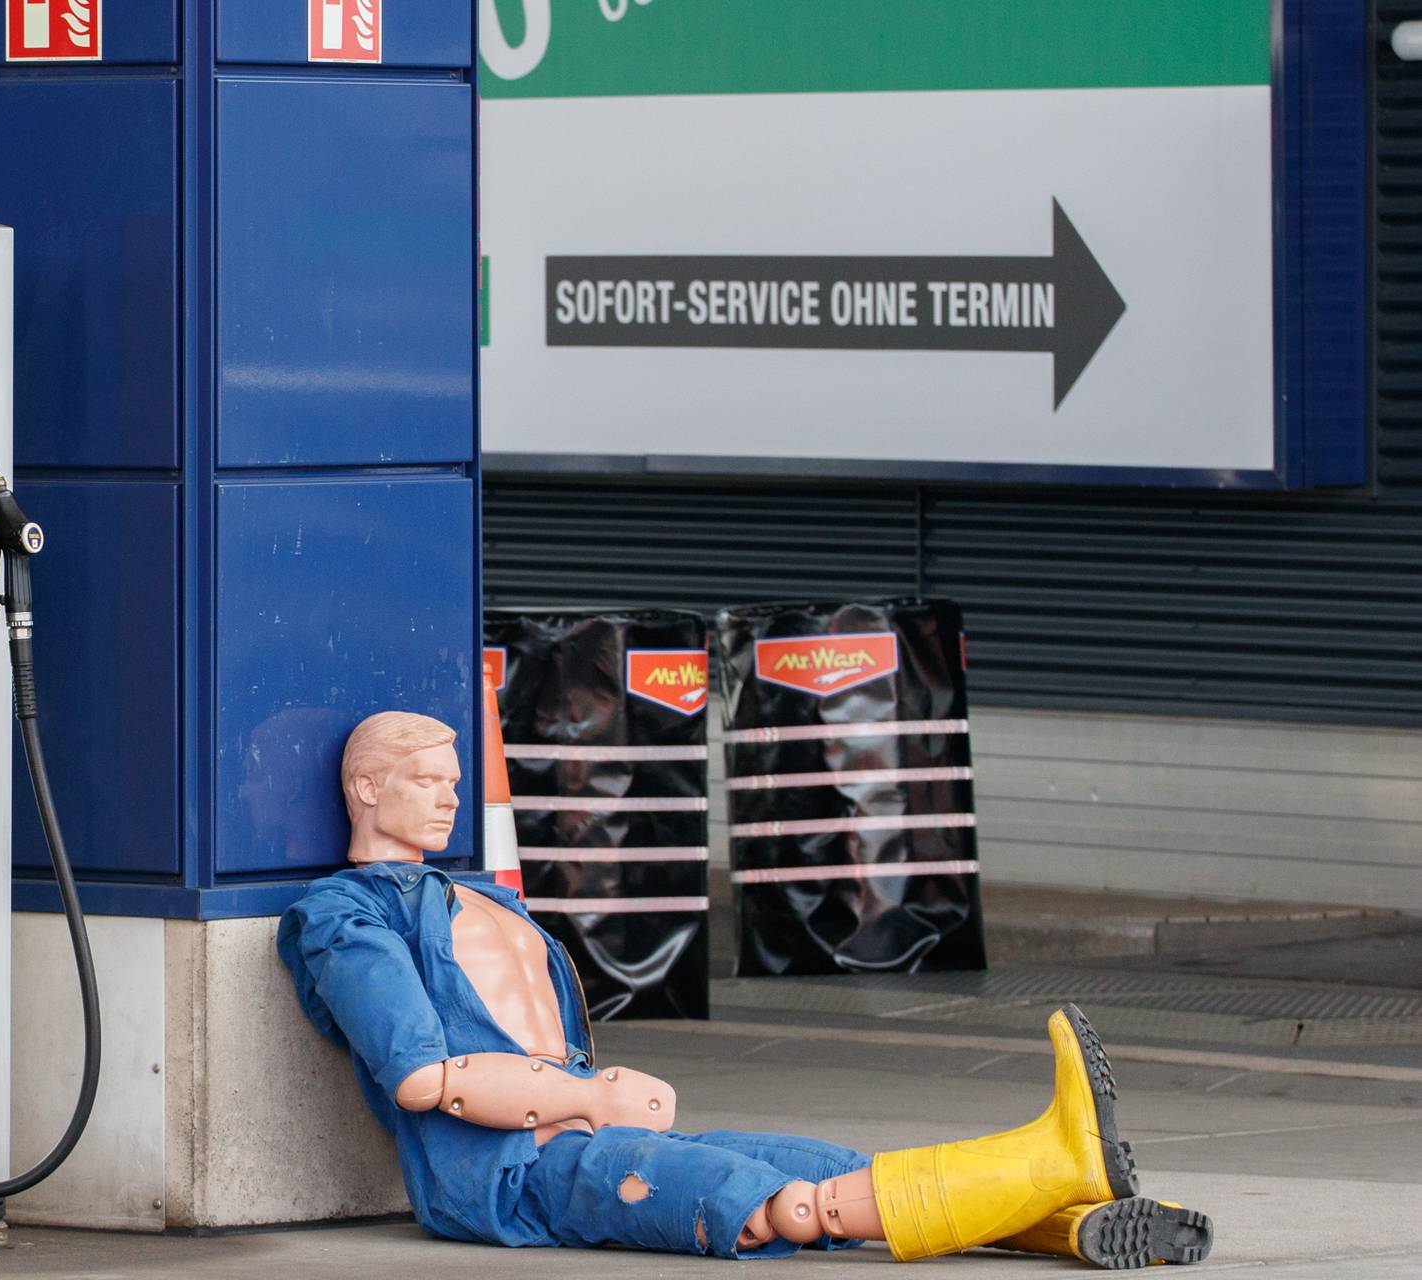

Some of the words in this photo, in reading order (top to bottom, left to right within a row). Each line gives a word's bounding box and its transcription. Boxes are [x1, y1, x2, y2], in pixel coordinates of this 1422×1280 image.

[555, 279, 821, 327] SOFORT-SERVICE
[830, 280, 918, 327] OHNE
[927, 281, 1056, 329] TERMIN
[644, 660, 706, 688] Mr.Wa
